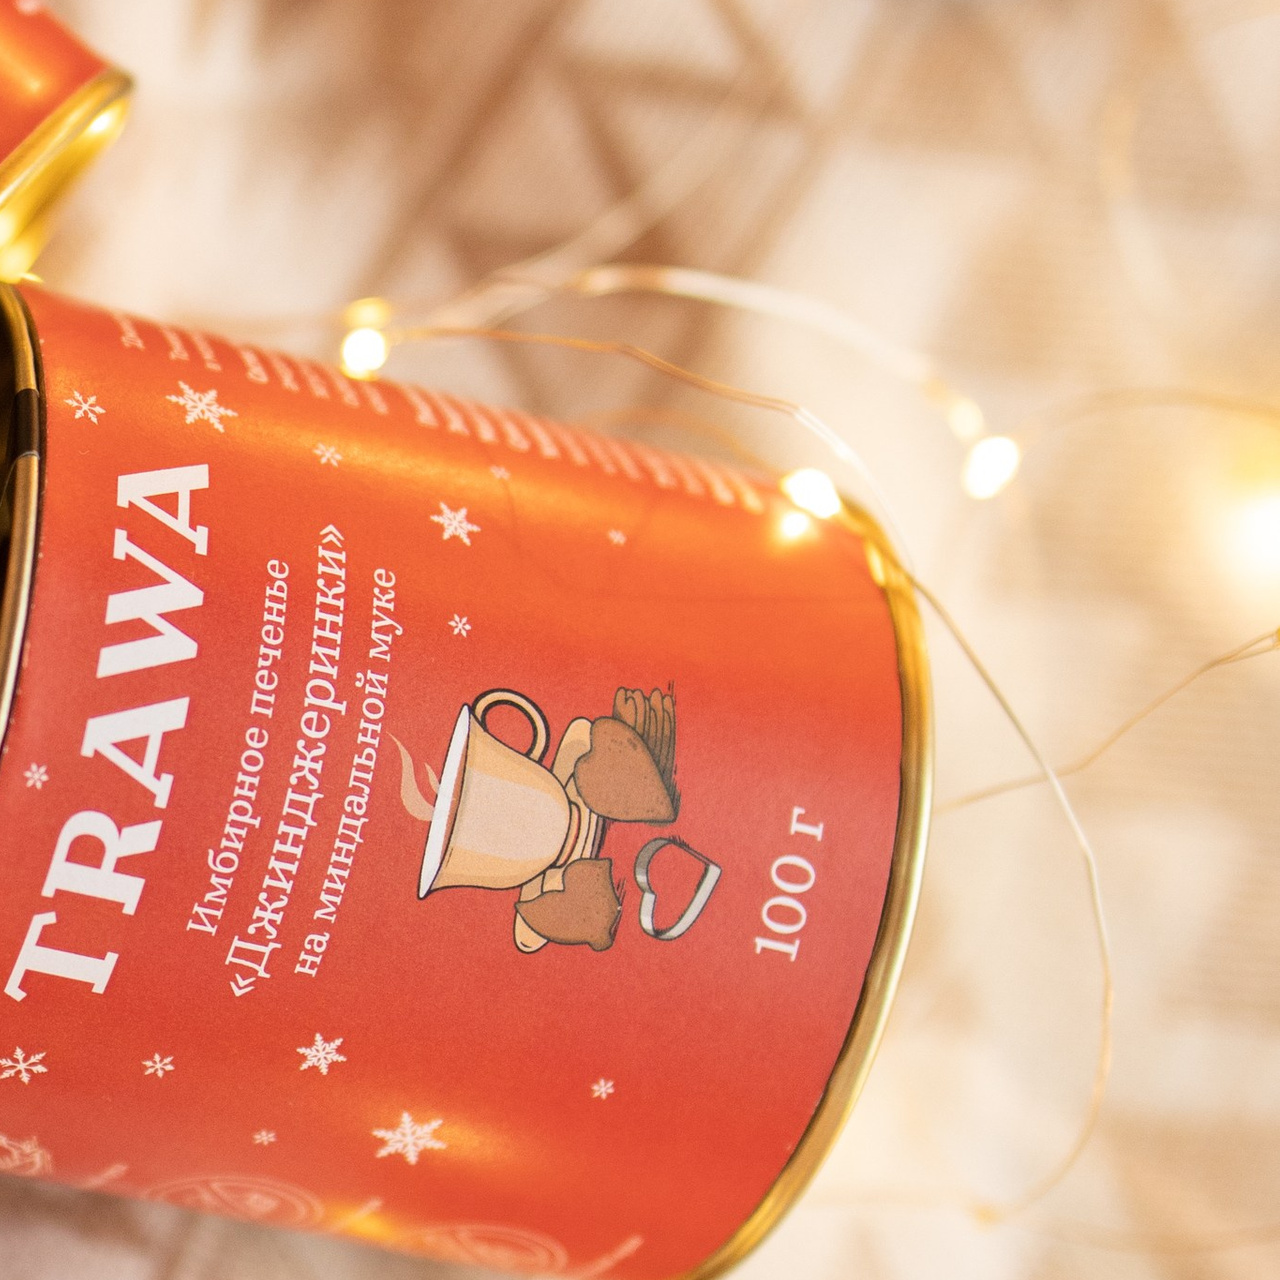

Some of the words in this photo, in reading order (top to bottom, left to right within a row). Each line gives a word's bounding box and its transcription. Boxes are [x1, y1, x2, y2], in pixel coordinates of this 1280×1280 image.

[3, 463, 211, 1003] TRAWA
[186, 726, 269, 937] Имбирное
[249, 559, 290, 719] печенье
[224, 524, 348, 998] «Джинджеринки»
[293, 931, 330, 978] на
[313, 669, 390, 924] миндальной
[369, 568, 403, 663] муке
[754, 854, 816, 962] 100
[789, 805, 825, 842] г
